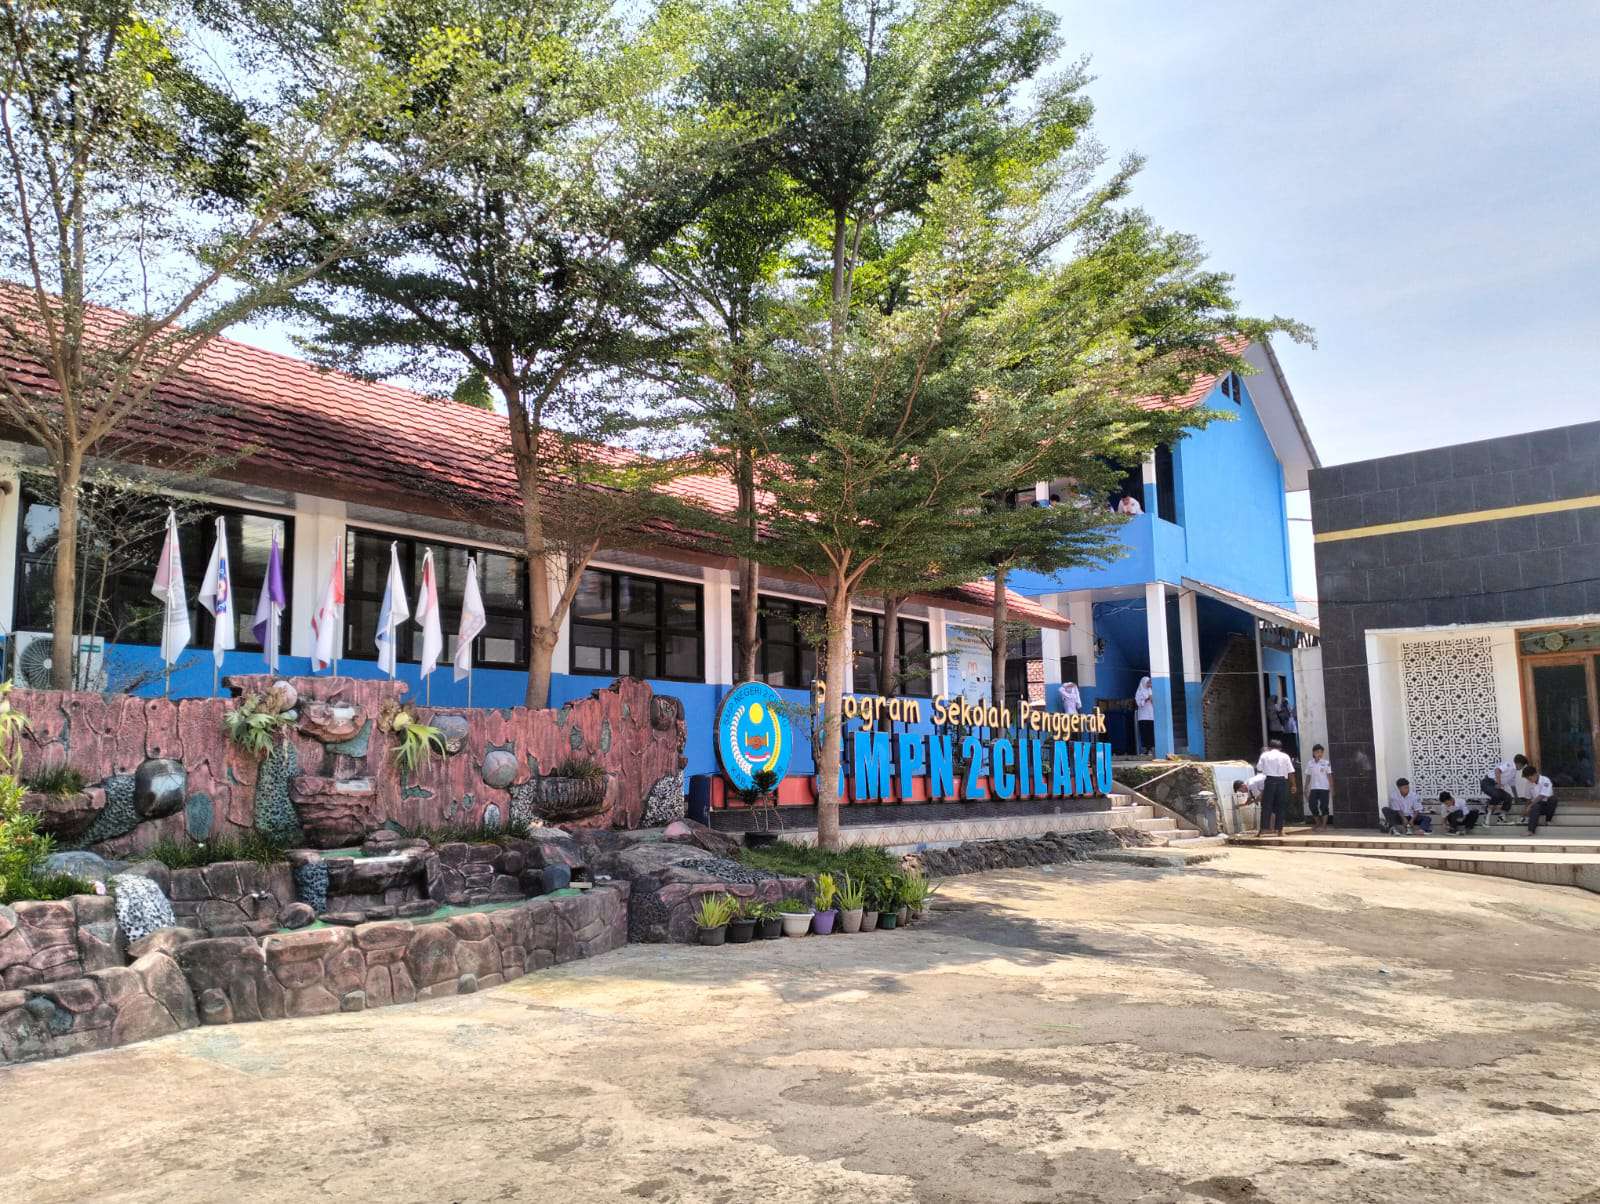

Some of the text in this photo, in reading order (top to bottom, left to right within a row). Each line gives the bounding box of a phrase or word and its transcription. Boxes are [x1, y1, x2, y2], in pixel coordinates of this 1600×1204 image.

[734, 687, 761, 704] NEGERI
[816, 680, 1107, 741] Pogram Sekolah Penggerak
[816, 730, 954, 800] MPN
